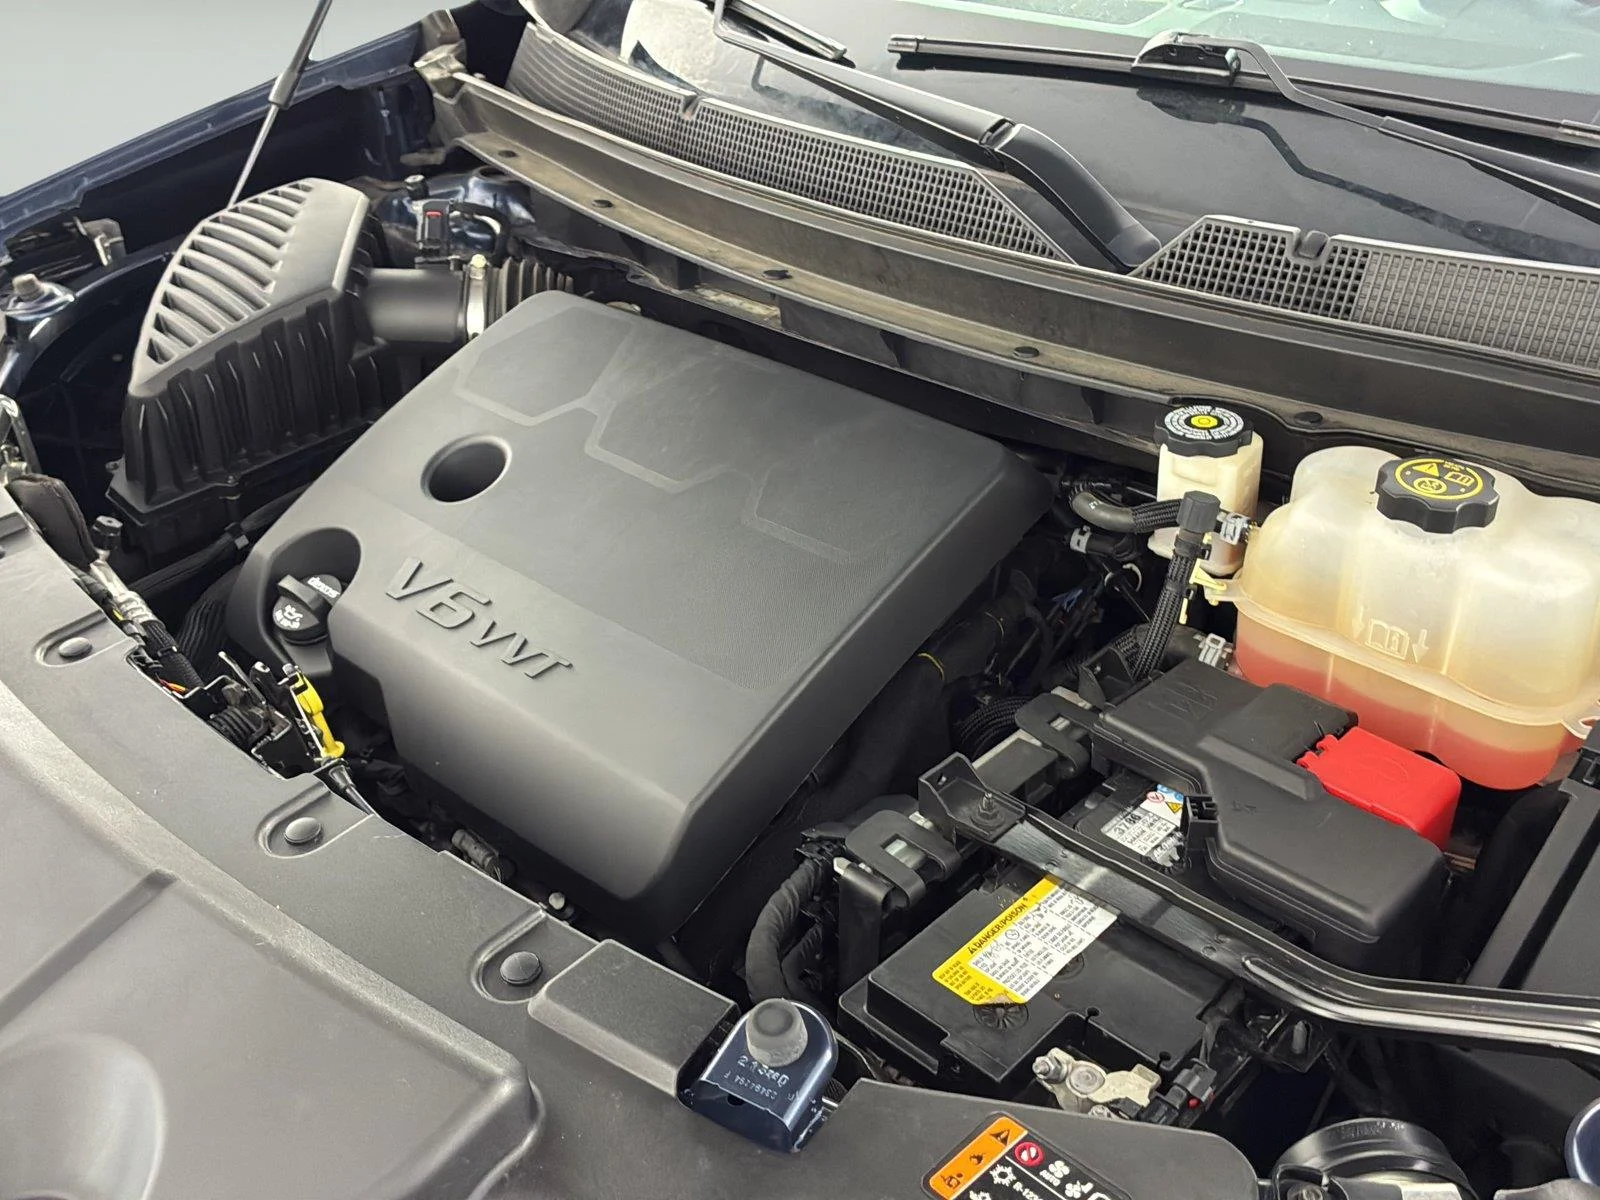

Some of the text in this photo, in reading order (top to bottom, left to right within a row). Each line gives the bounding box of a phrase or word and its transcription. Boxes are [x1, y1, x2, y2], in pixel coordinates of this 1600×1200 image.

[385, 557, 574, 680] V6 VVT
[974, 903, 1028, 951] DANGER/POISON
[1013, 1181, 1043, 1200] R-123
[1039, 1169, 1061, 1187] AUTO
